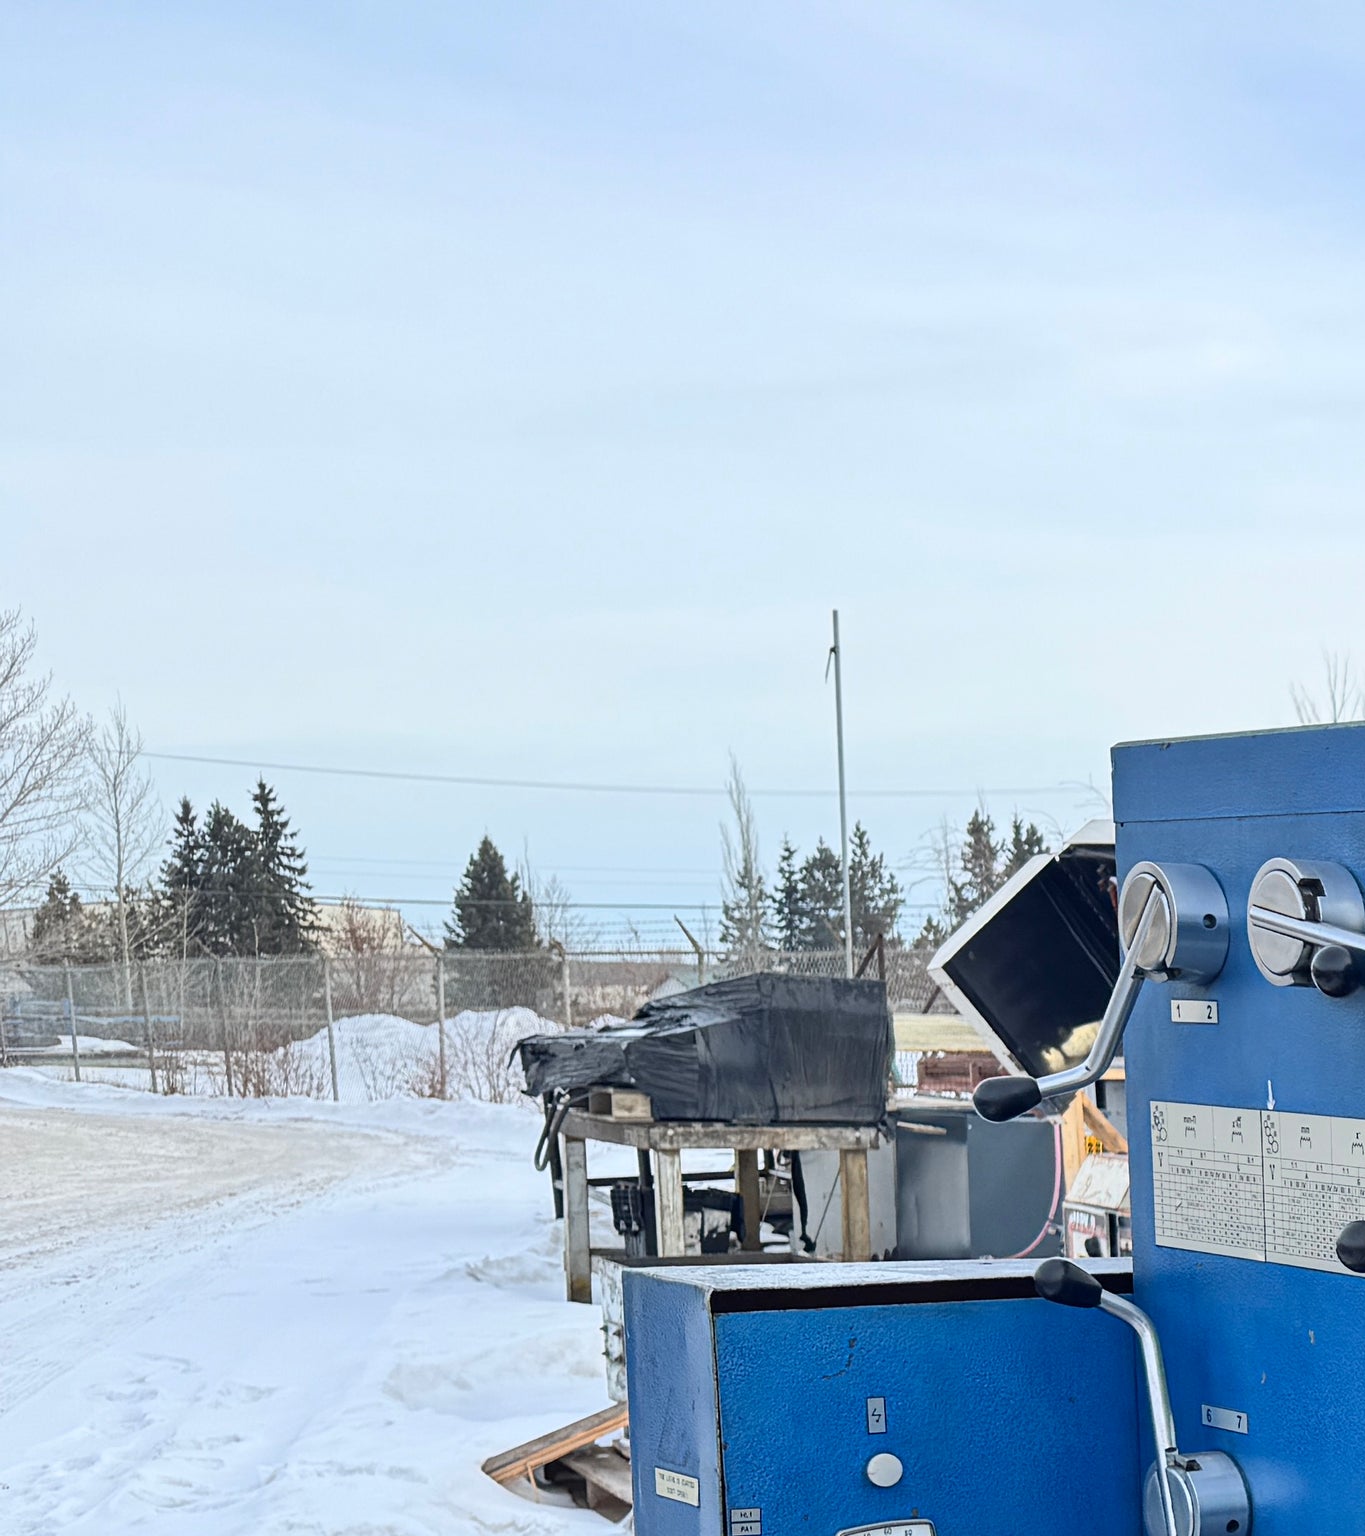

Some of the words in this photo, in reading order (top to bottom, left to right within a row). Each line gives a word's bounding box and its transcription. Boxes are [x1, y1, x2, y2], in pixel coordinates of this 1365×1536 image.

[1176, 1003, 1181, 1019] 1
[1206, 1004, 1213, 1020] 2
[1206, 1408, 1212, 1423] 6
[1236, 1414, 1242, 1429] 7
[904, 1528, 913, 1536] 80
